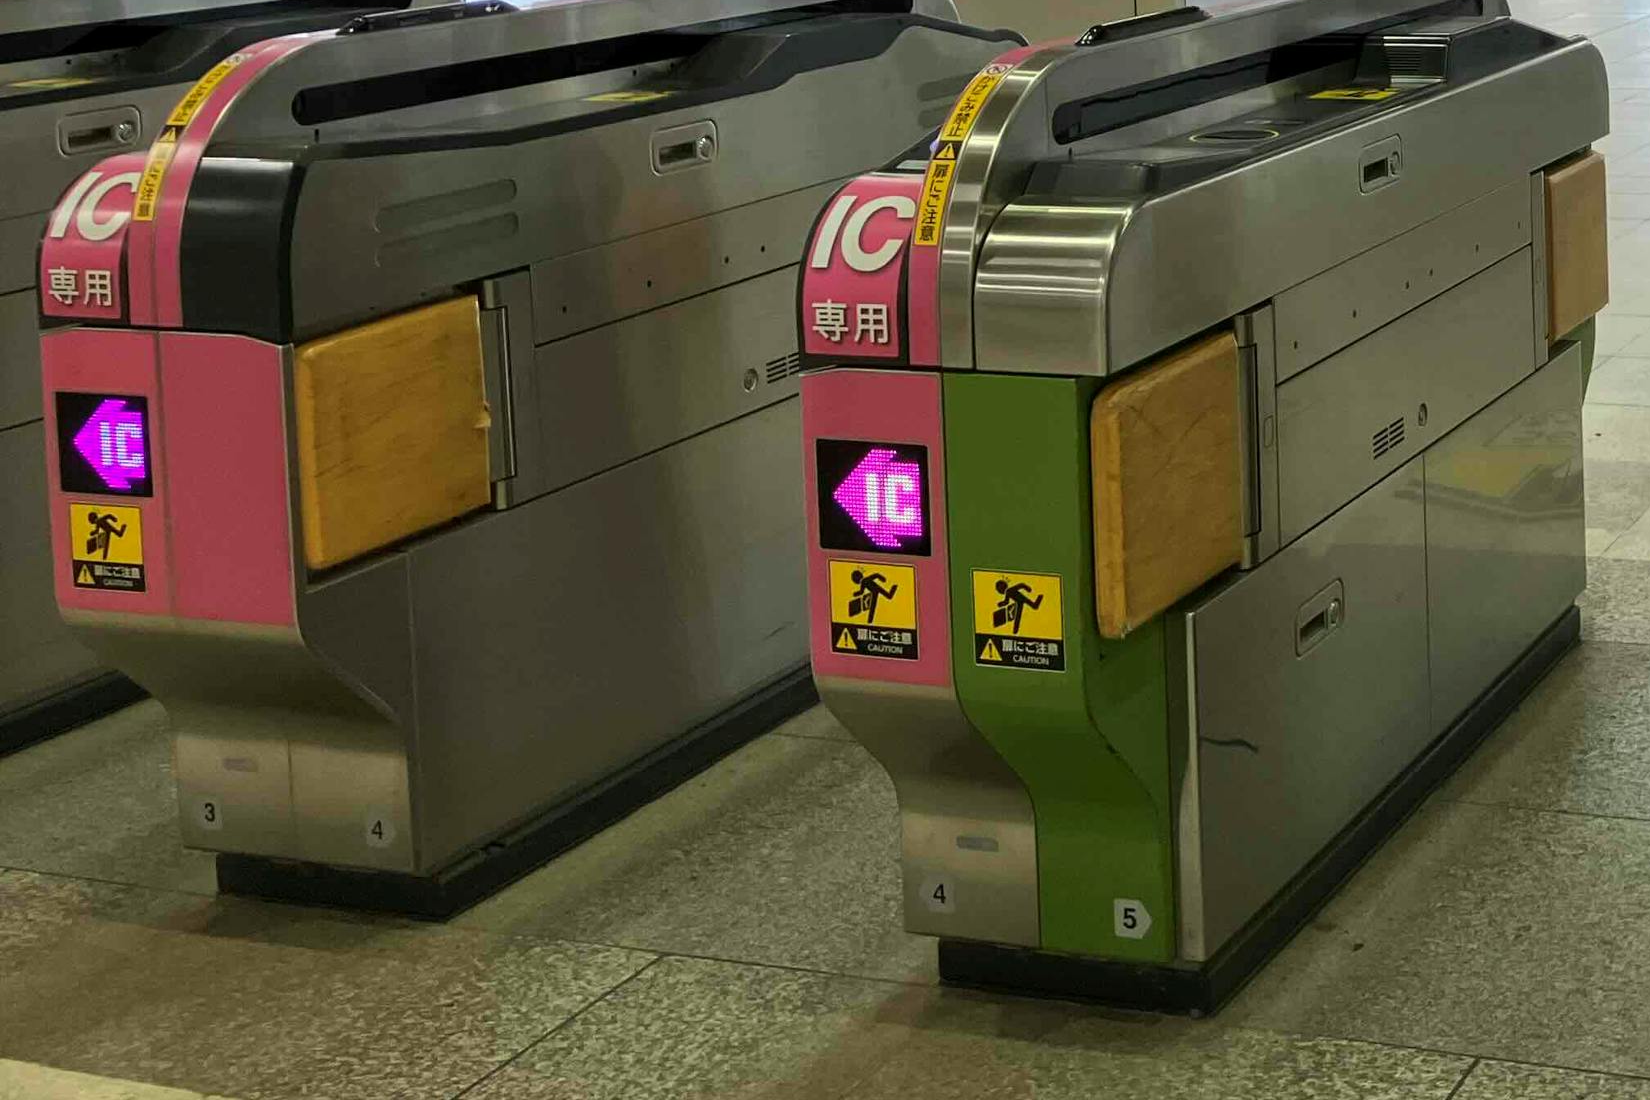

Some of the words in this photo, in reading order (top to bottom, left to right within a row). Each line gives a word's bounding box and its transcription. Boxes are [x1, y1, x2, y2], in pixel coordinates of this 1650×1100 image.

[946, 75, 996, 137] かけこみ禁止
[51, 172, 139, 241] IC
[919, 164, 949, 241] 扉にご注意
[811, 195, 916, 272] IC
[48, 266, 112, 307] 専用
[811, 299, 889, 343] 専用
[99, 421, 144, 467] IC
[864, 473, 916, 522] IC
[856, 628, 913, 645] 扉にご注意
[867, 644, 903, 654] CAUTION
[1002, 639, 1059, 656] 扉にご注意
[1013, 654, 1049, 665] CAUTION
[204, 804, 215, 822] 3
[371, 820, 384, 839] 4
[932, 884, 947, 904] 4
[1122, 908, 1137, 929] 5
